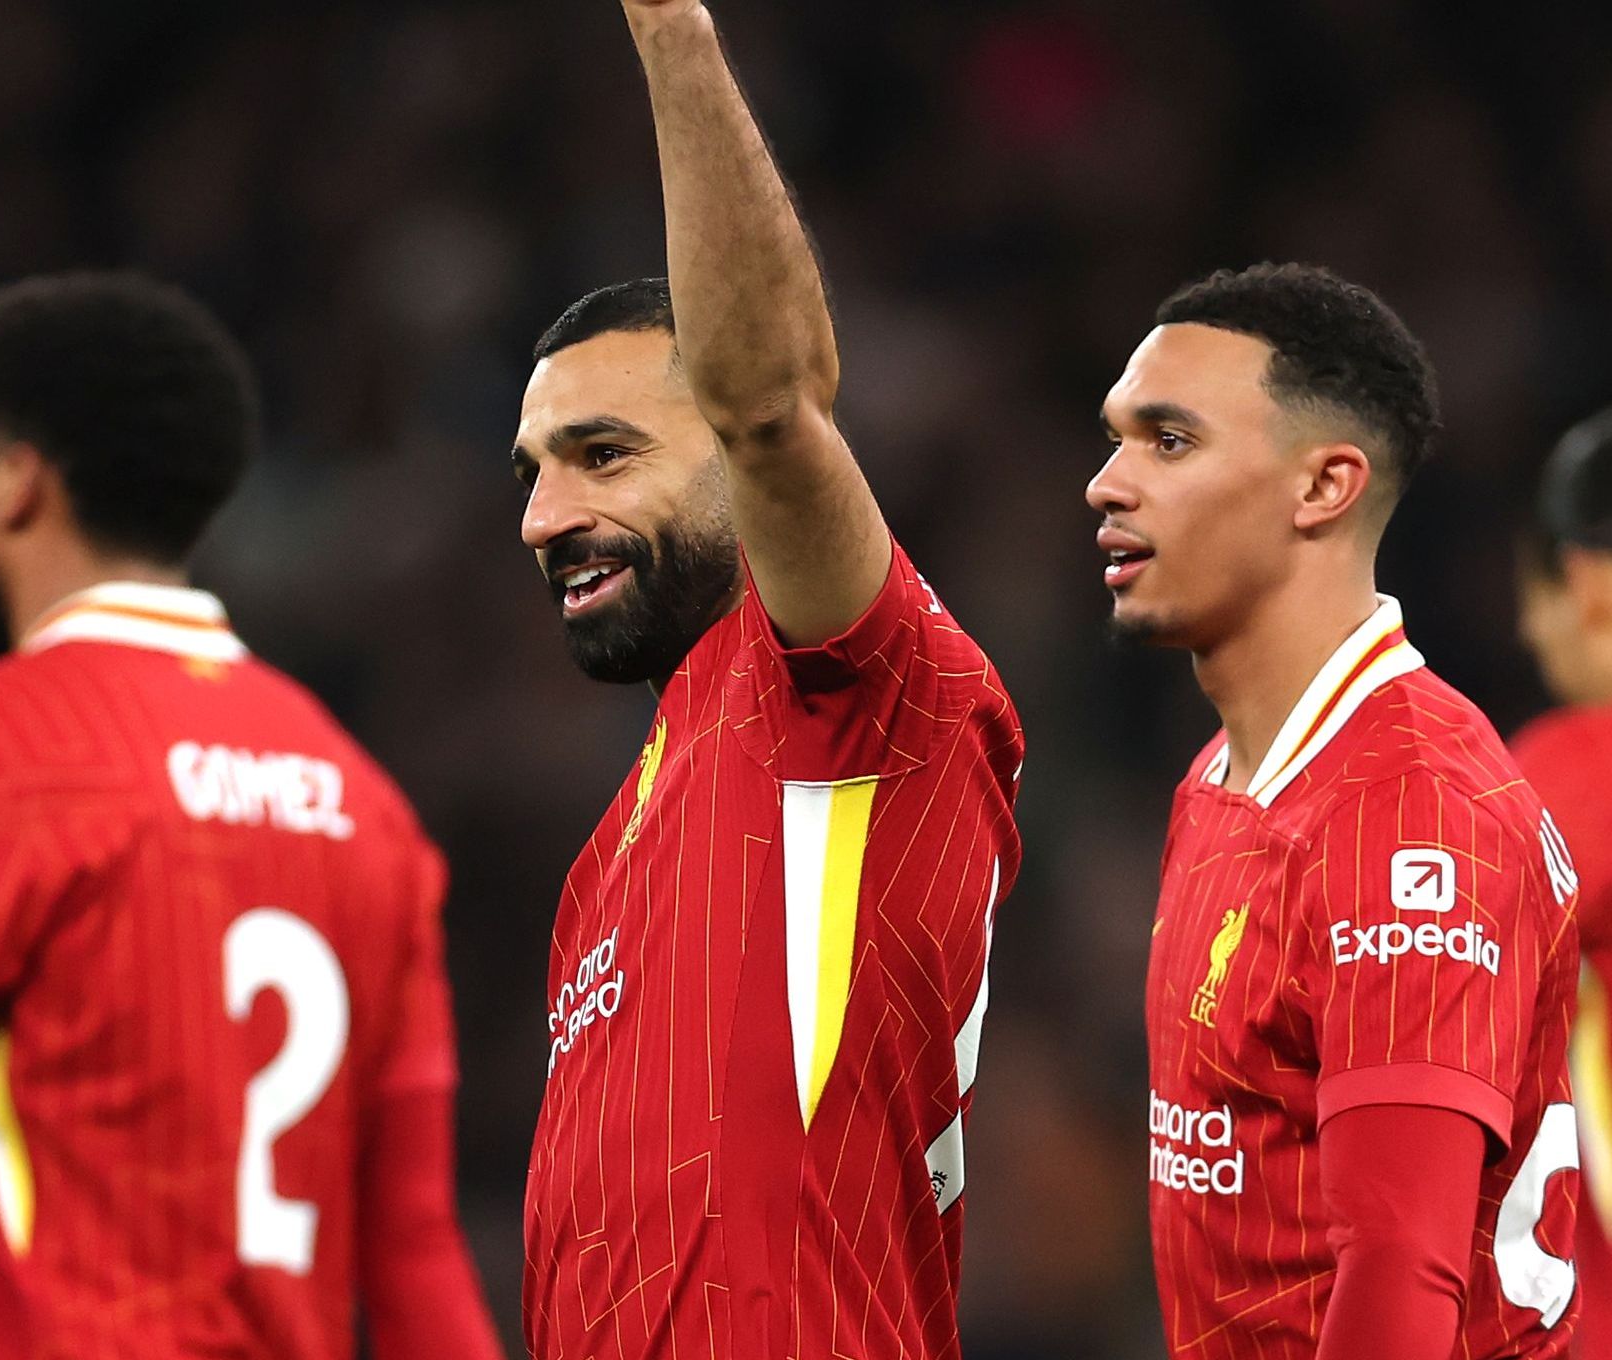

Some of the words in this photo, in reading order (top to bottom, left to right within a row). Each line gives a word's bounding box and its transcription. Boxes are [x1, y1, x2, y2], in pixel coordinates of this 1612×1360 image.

[169, 741, 354, 840] GOMEZ
[1330, 920, 1500, 976] Expedia
[222, 908, 351, 1275] 2
